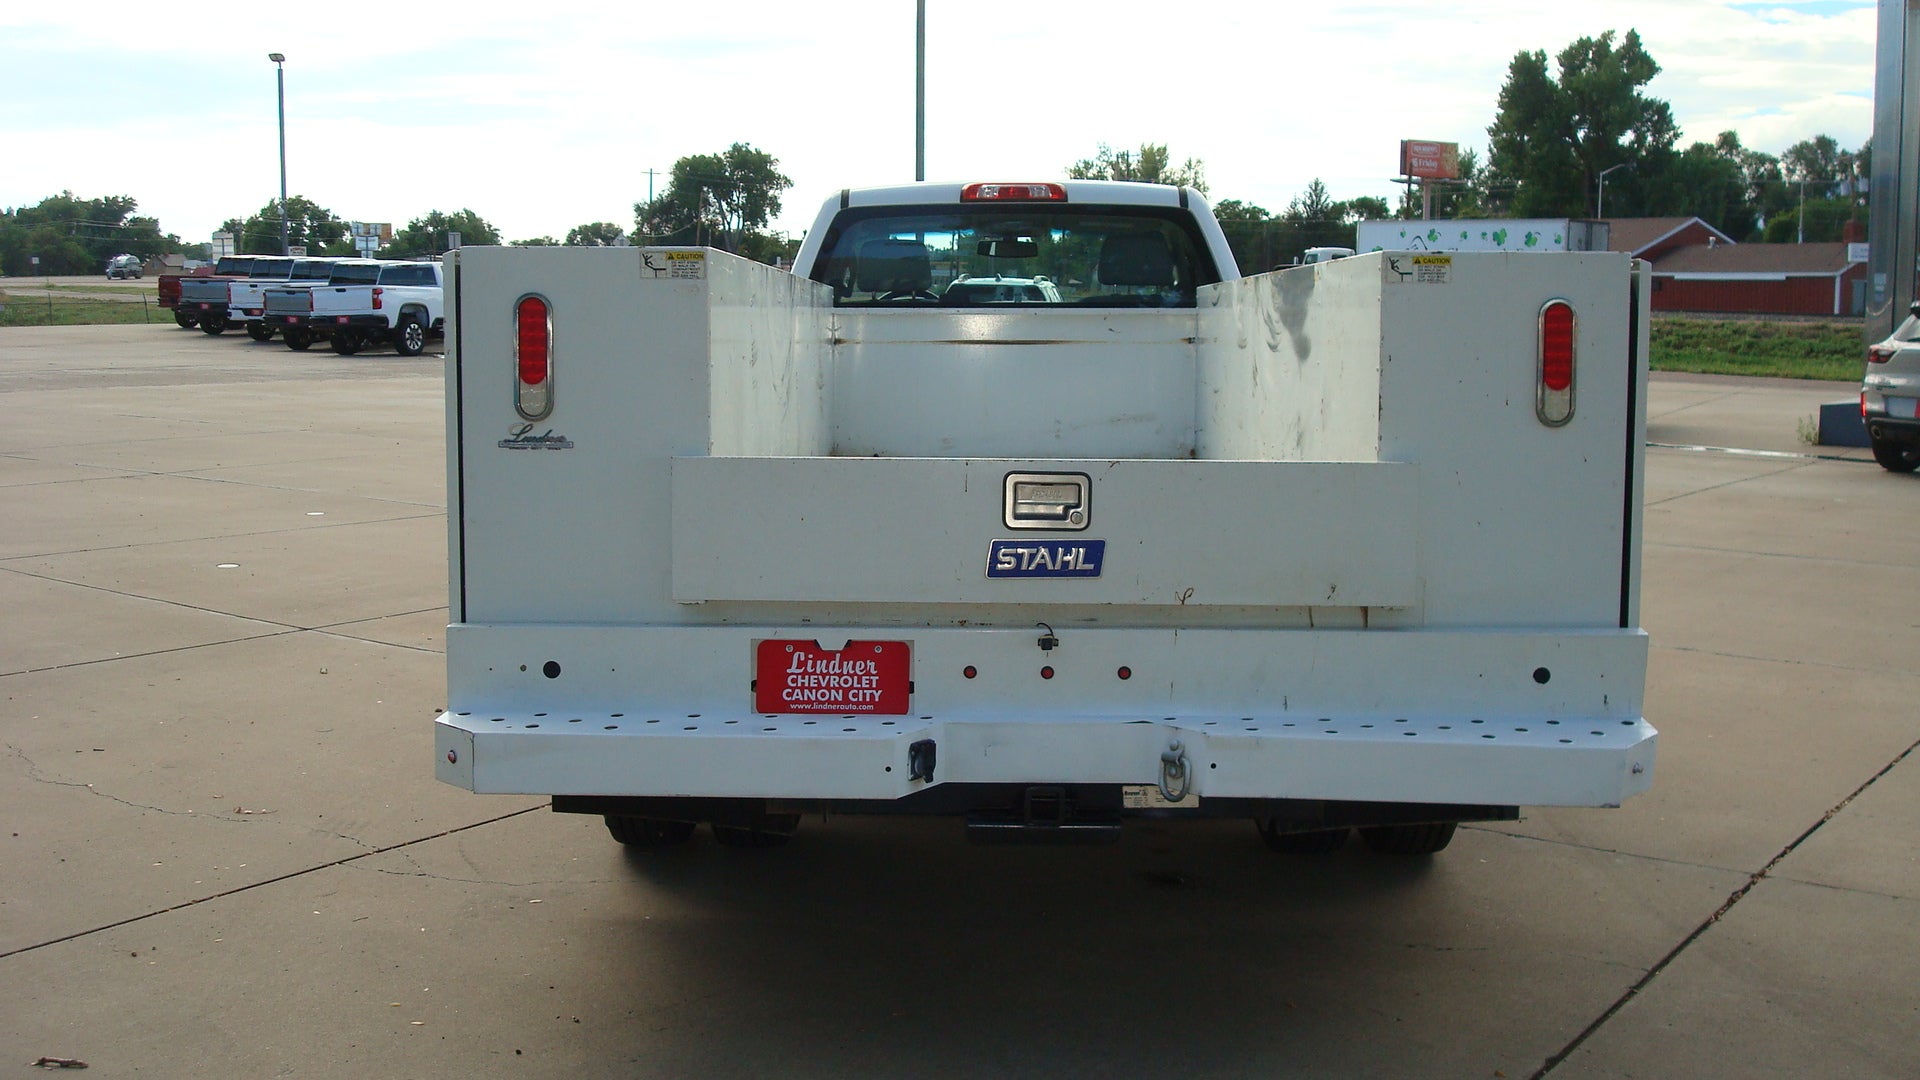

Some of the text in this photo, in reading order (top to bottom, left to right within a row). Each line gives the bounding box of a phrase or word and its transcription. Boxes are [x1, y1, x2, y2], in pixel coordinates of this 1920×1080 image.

[996, 546, 1095, 571] STAHL
[786, 651, 878, 676] Lindner
[787, 675, 879, 688] CHEVROLET
[782, 689, 883, 702] CANON CITY
[790, 702, 874, 711] www.lindnerauto.com
